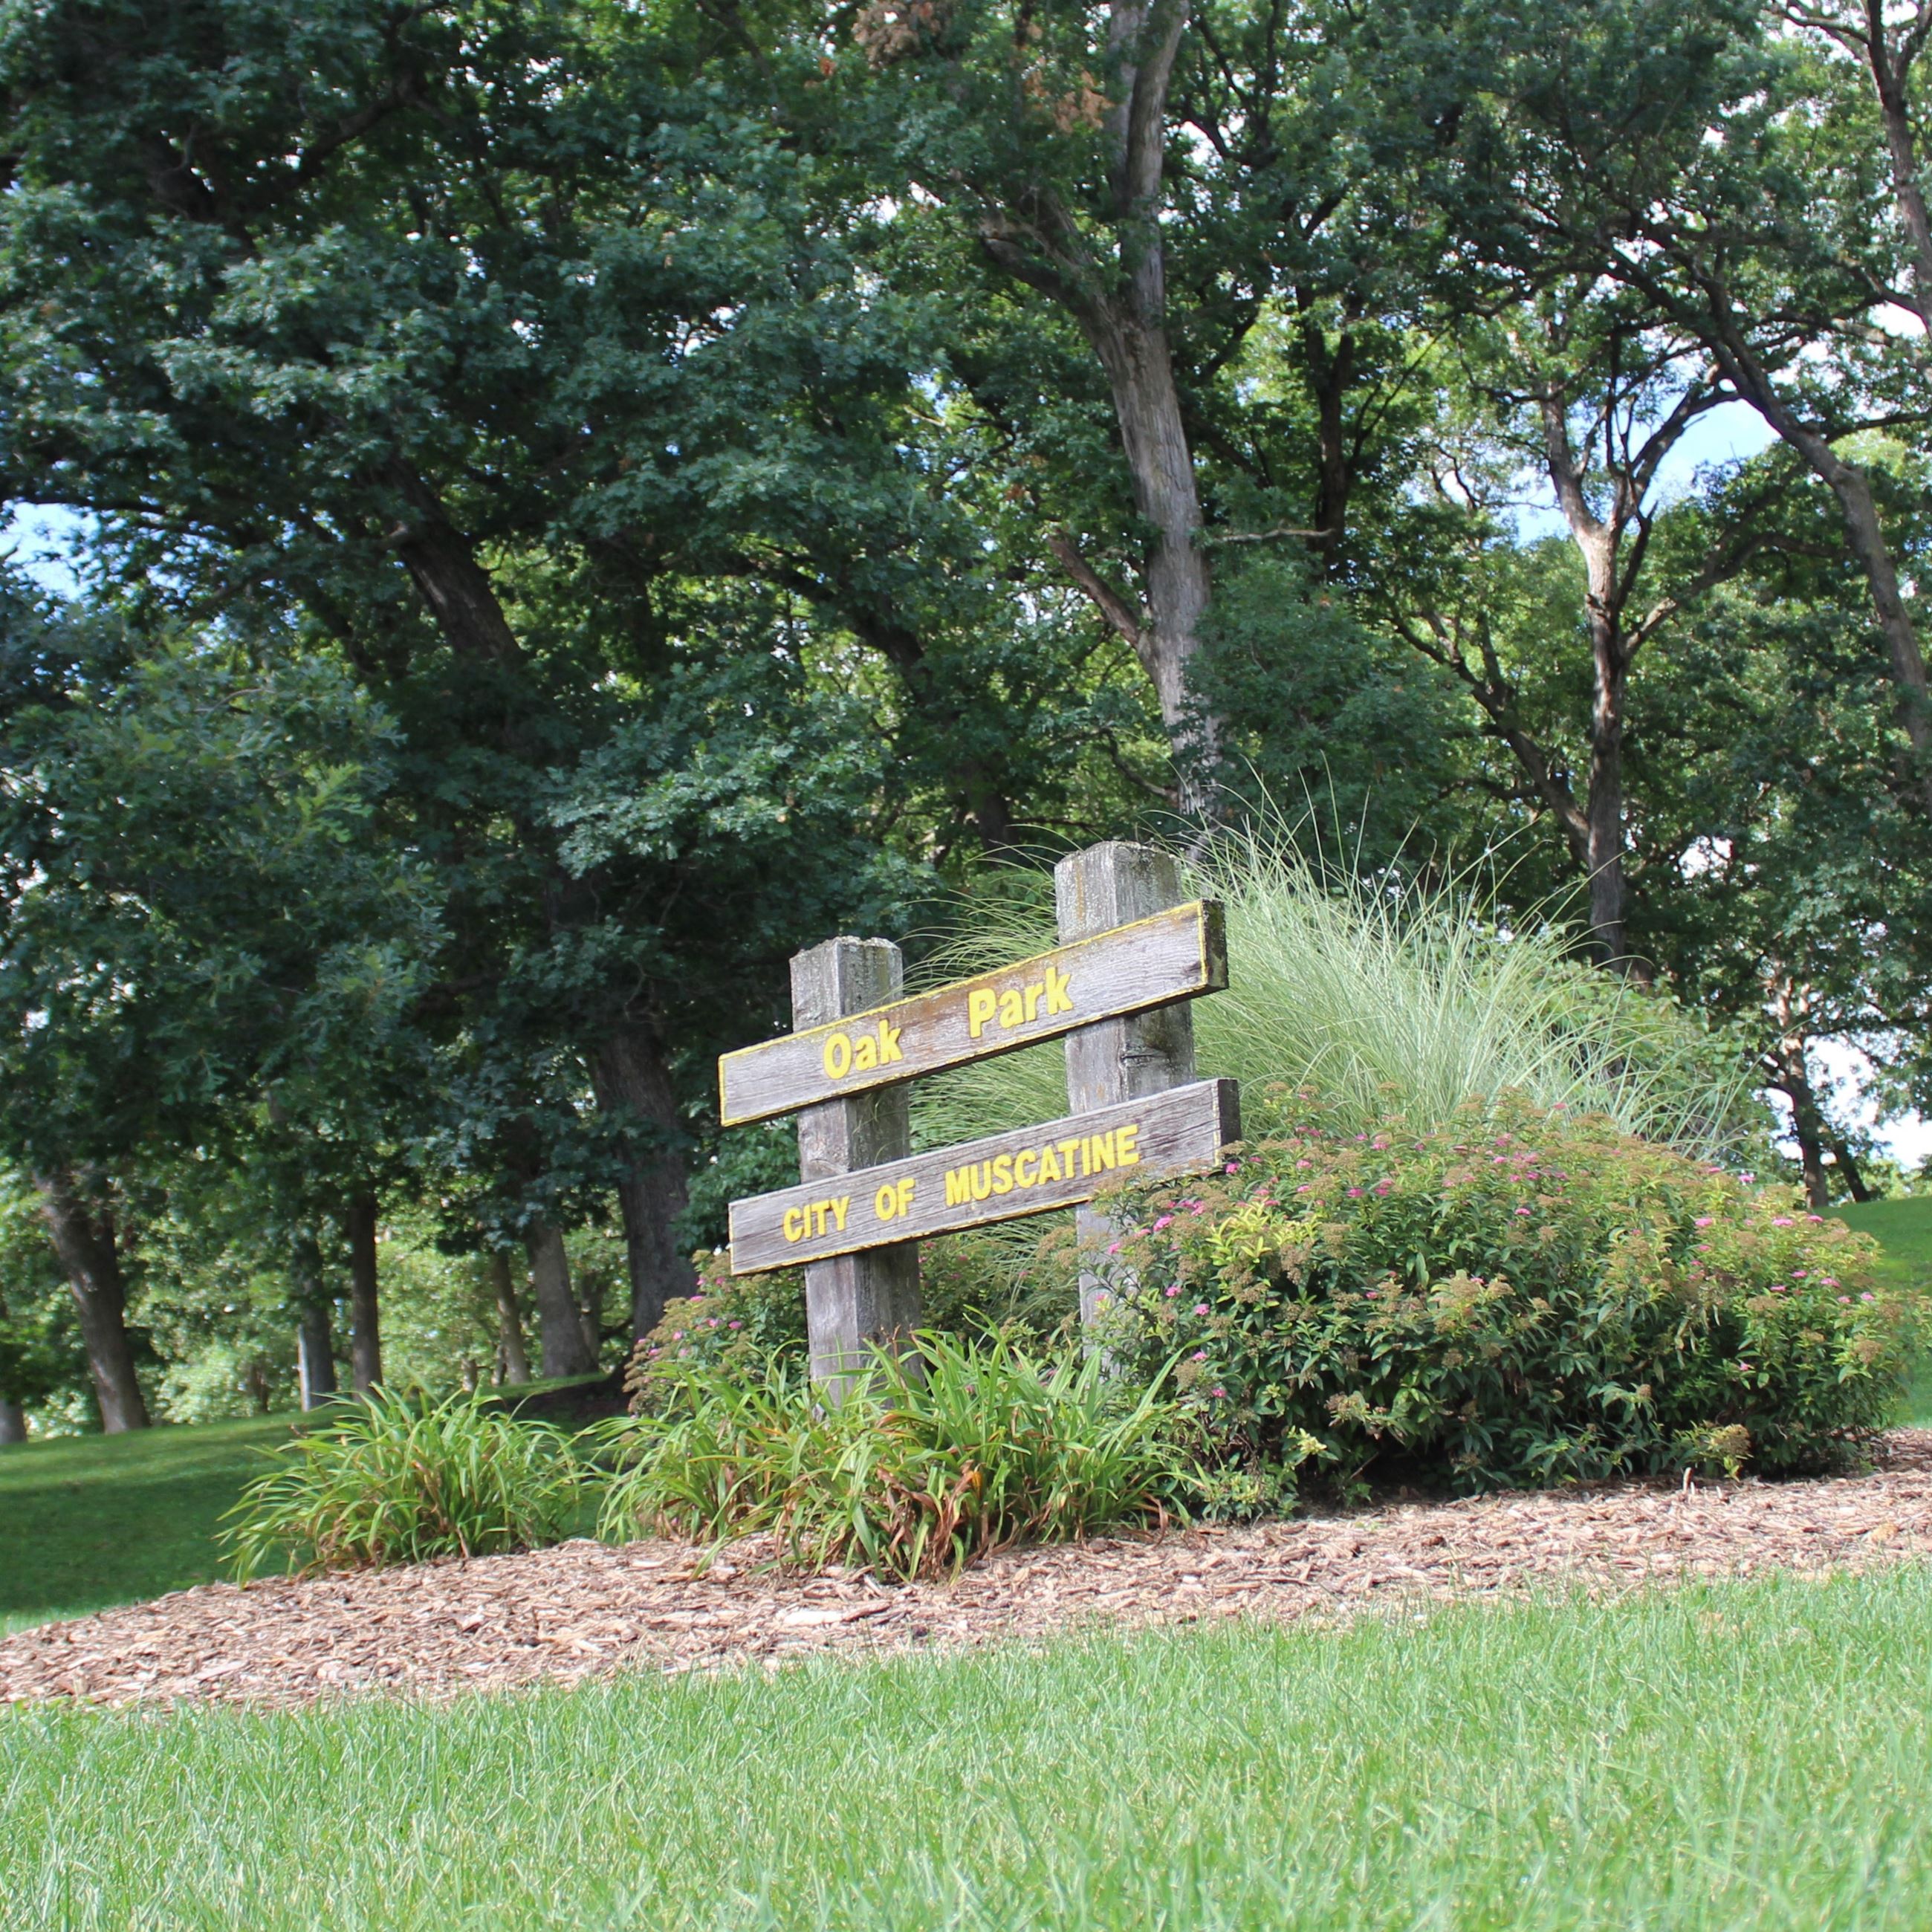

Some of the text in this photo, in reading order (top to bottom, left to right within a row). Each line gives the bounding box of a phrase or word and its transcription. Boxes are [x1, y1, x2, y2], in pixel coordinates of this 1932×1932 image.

[823, 966, 1074, 1080] Oak Park
[782, 1123, 1141, 1243] CITY OF MUSCATINE
